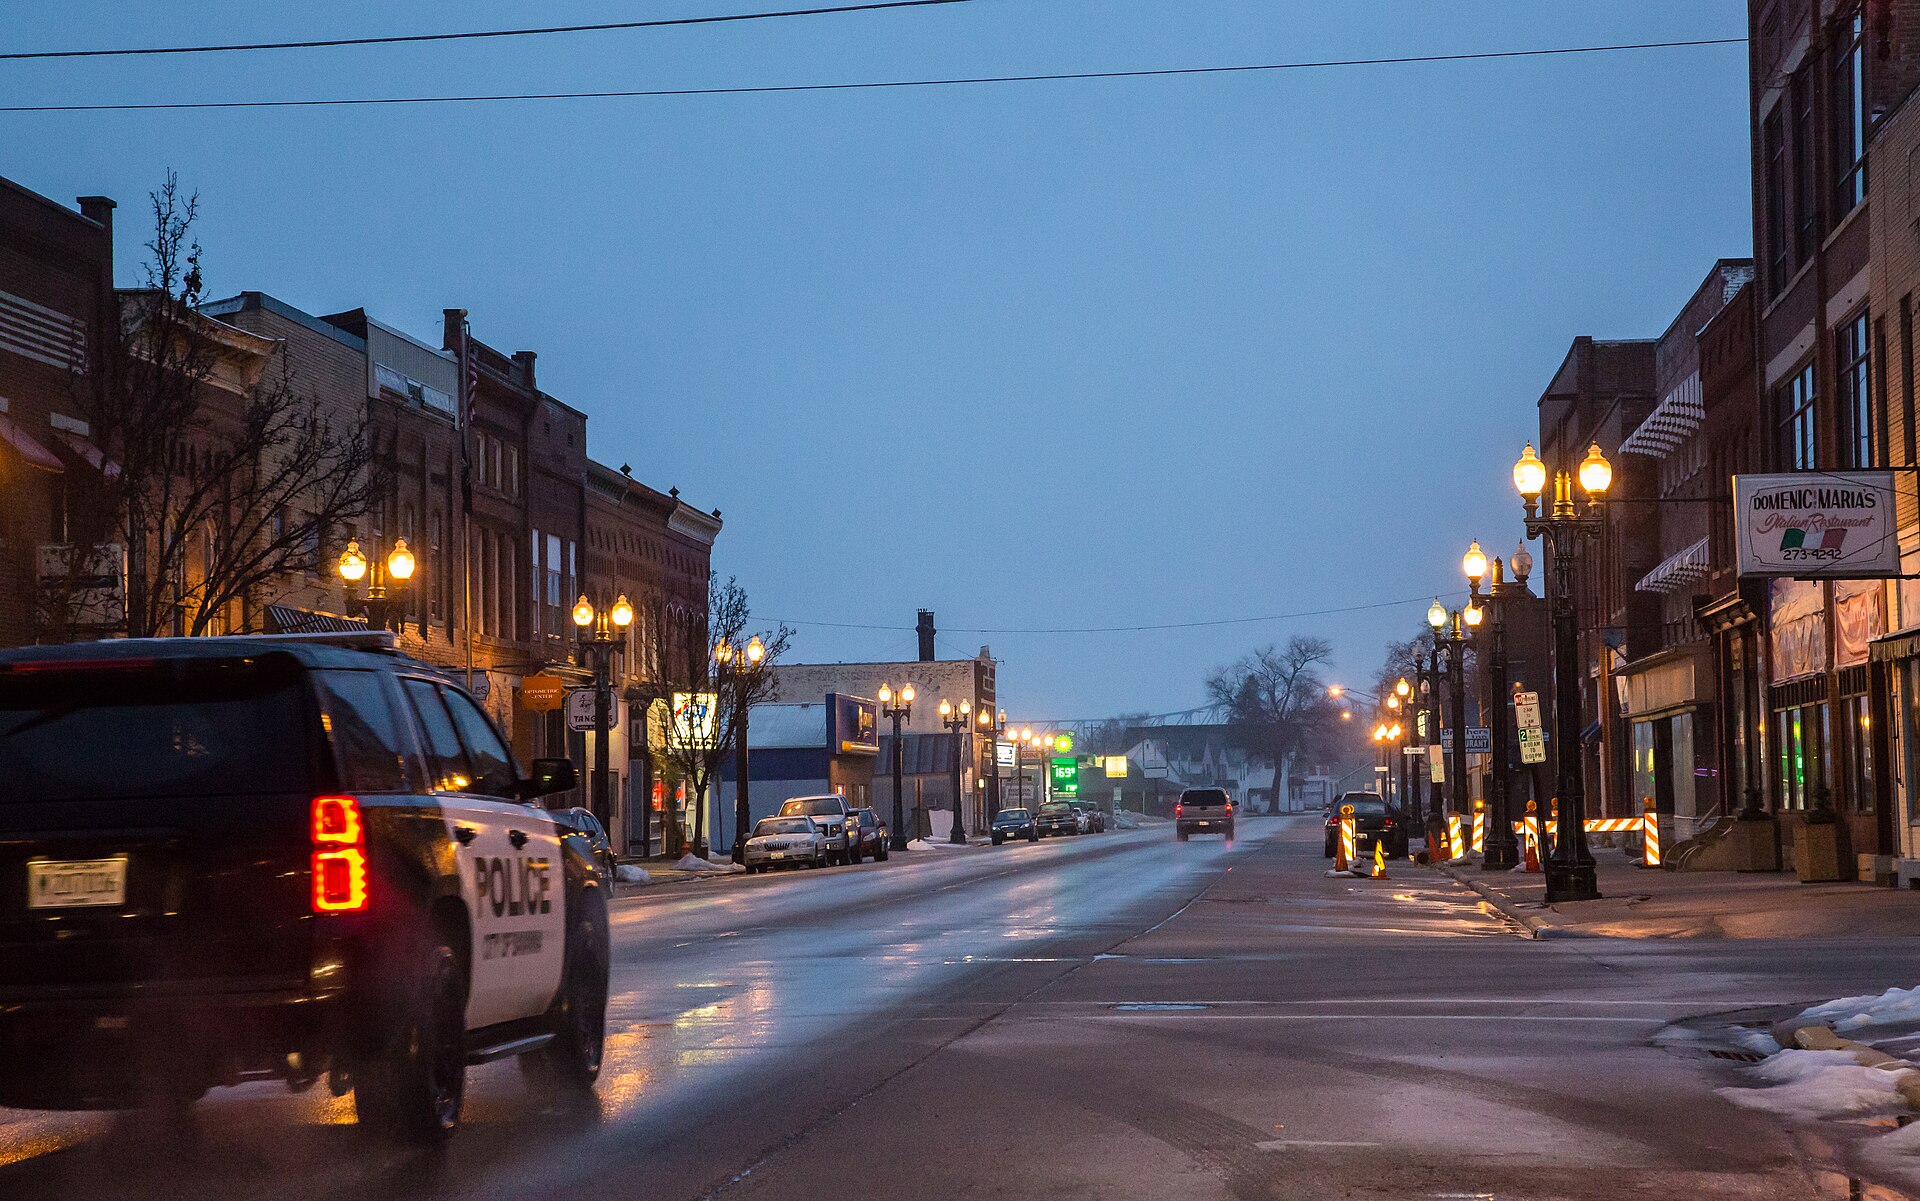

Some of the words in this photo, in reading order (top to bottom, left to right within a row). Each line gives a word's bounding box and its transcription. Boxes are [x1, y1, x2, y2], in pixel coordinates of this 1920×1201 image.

[1753, 488, 1813, 510] DOMENIC
[1818, 488, 1876, 509] MARIA'S
[1756, 513, 1808, 534] Italian
[1805, 513, 1875, 533] Restaurant
[1783, 549, 1842, 560] 273-4242
[573, 715, 613, 723] TANGS
[1520, 731, 1527, 740] 2
[1443, 739, 1488, 748] REURANT
[474, 856, 551, 919] POLICE
